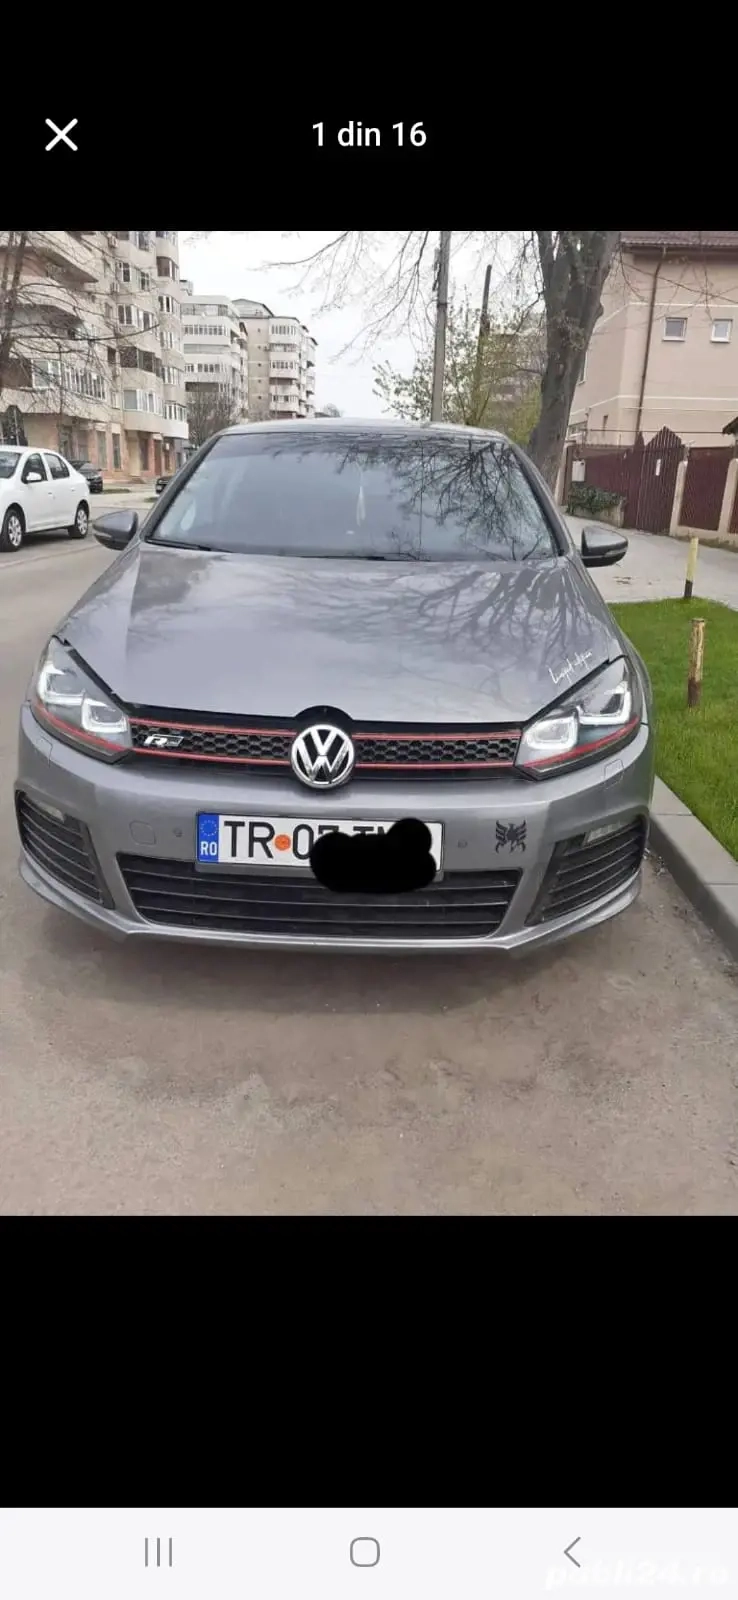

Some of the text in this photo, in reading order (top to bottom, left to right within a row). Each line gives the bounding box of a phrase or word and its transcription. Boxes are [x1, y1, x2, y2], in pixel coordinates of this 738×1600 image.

[312, 120, 427, 147] 1 din 16
[200, 841, 217, 857] RO
